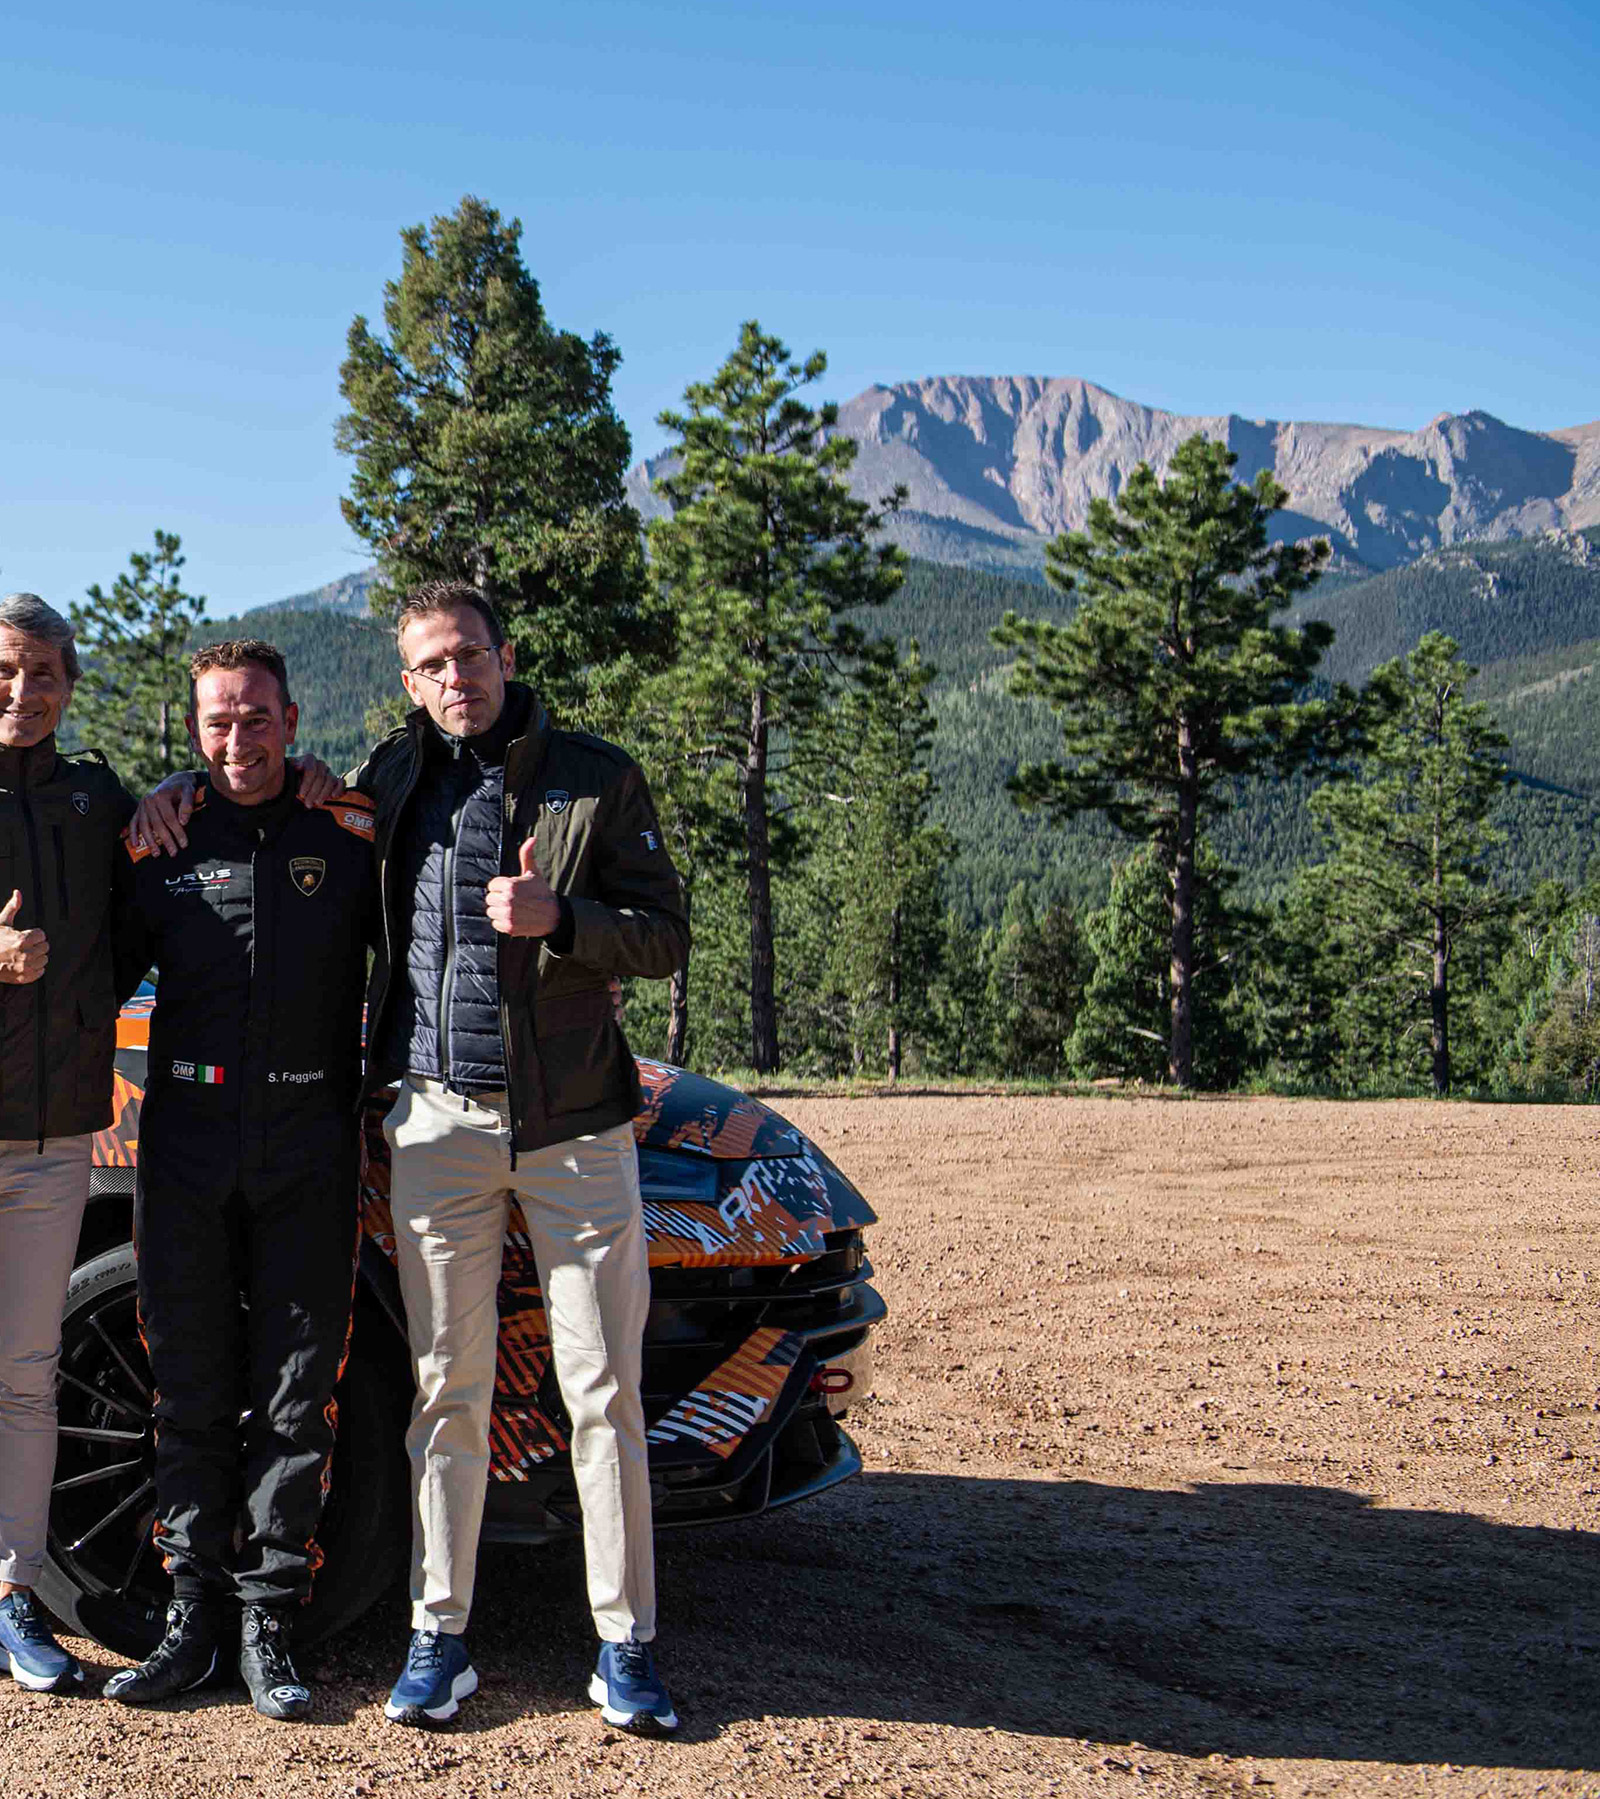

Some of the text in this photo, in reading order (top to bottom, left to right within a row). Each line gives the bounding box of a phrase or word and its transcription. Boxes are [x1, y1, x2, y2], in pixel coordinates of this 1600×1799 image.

[344, 814, 375, 828] OMP
[165, 868, 231, 885] URUS
[172, 1063, 195, 1077] OMP
[268, 1069, 324, 1083] S. Faggioli
